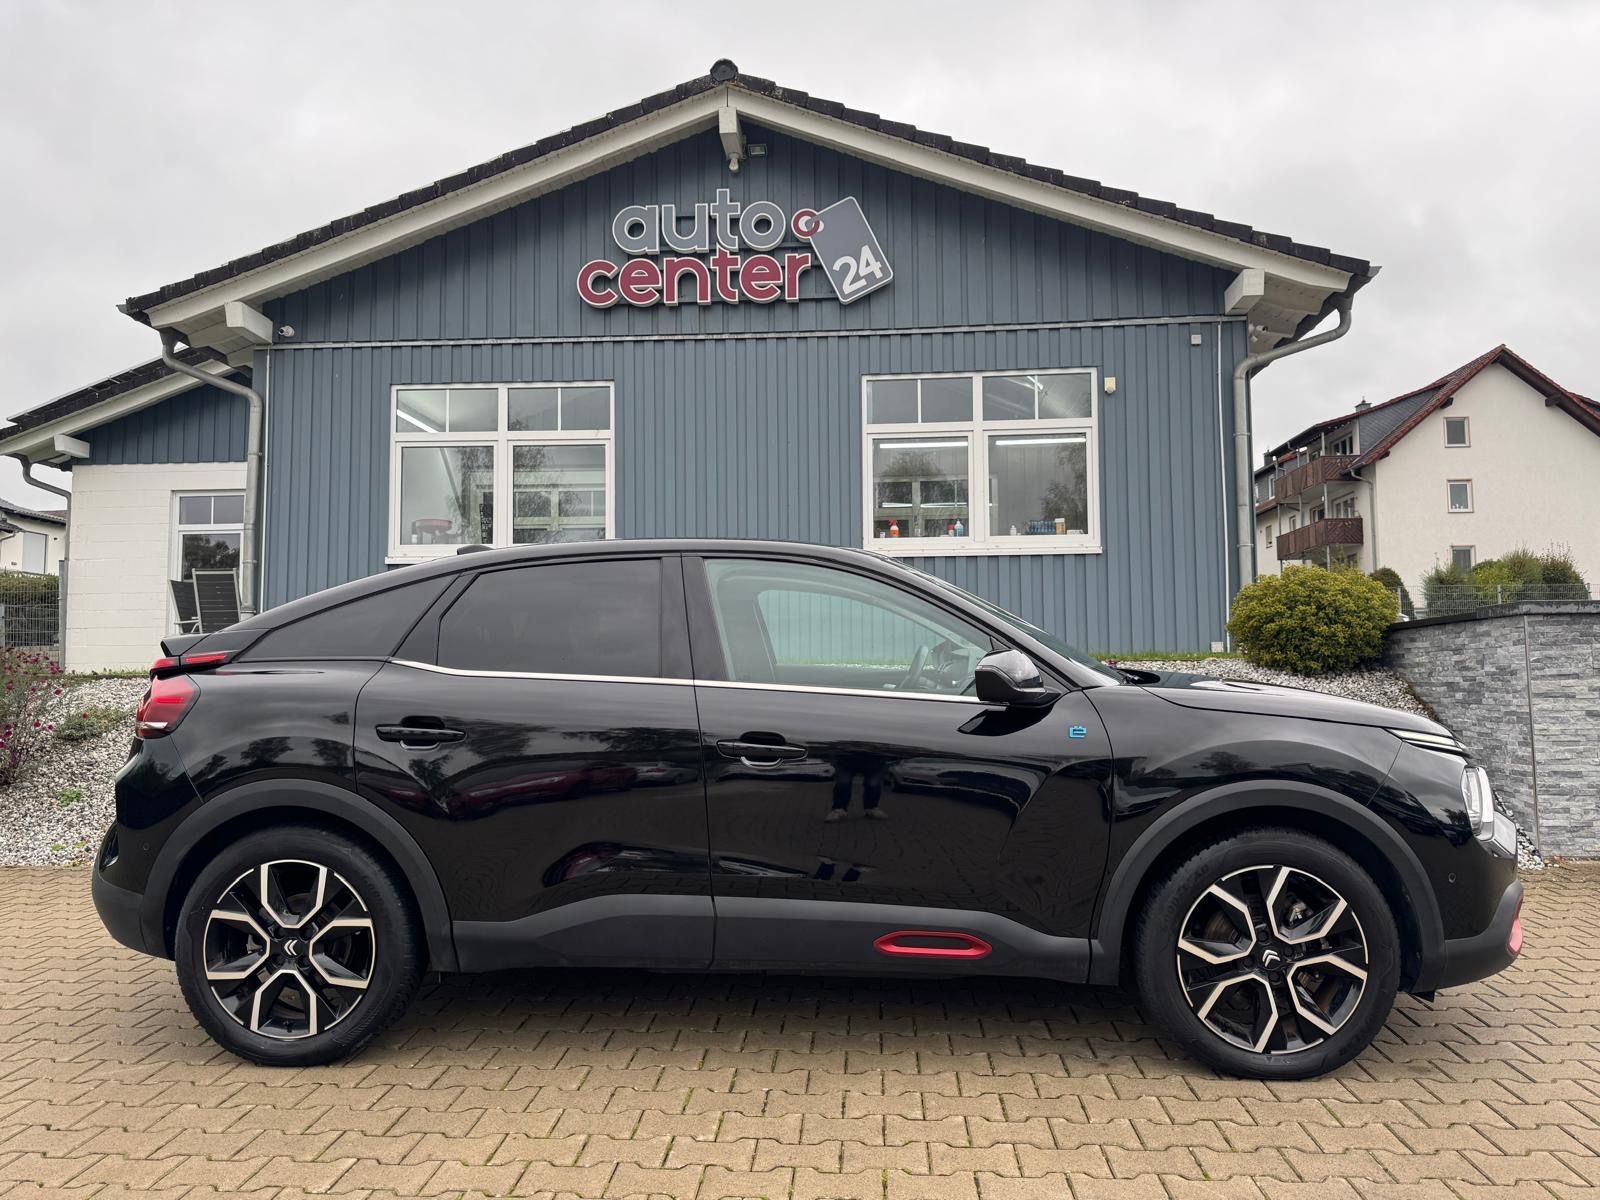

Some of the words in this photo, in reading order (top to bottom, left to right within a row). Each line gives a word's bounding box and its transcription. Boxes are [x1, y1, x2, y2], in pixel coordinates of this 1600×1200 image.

[612, 188, 786, 254] auto
[576, 243, 811, 307] center
[833, 244, 882, 294] 24
